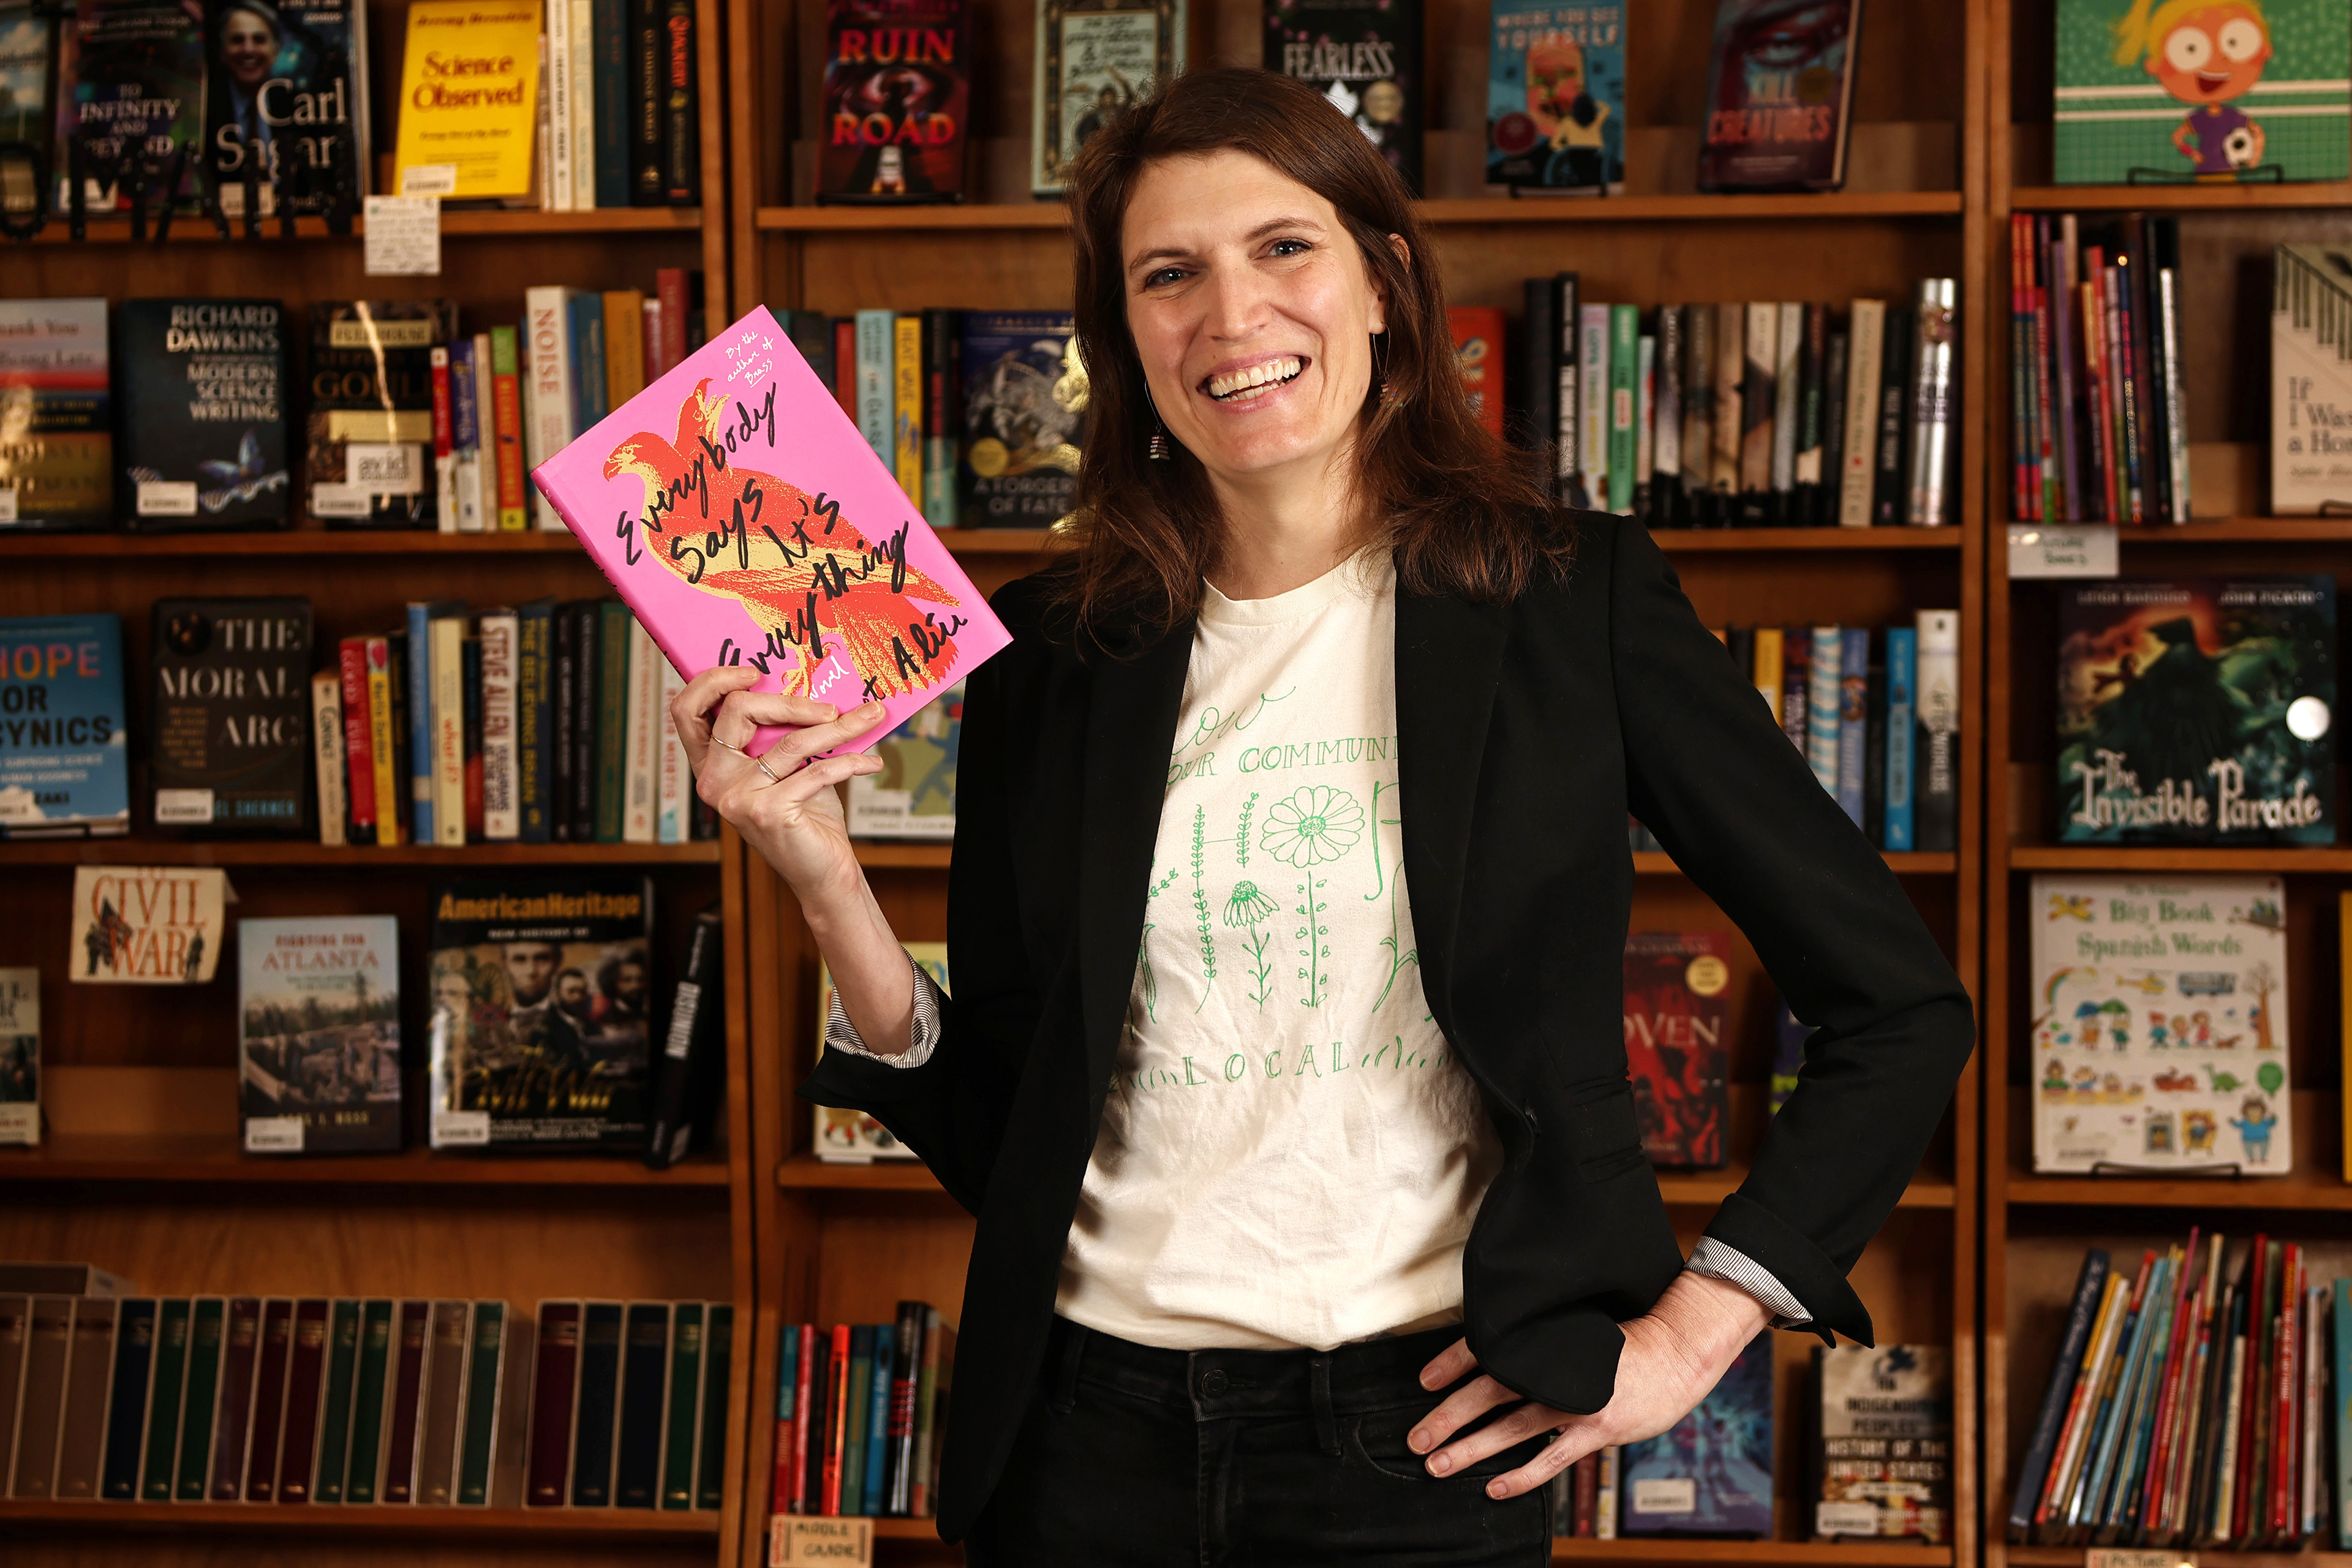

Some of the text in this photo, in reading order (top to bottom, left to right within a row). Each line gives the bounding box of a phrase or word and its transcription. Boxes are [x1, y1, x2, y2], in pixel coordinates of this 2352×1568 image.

[838, 28, 954, 64] RUIN
[1284, 40, 1395, 80] FEARLESS
[421, 50, 514, 80] Science
[80, 98, 181, 124] INFINITY
[256, 77, 347, 126] Carl
[412, 78, 525, 111] Observed
[832, 113, 956, 146] ROAD
[172, 305, 279, 328] RICHARD
[166, 328, 280, 353] DAWKINS
[533, 307, 560, 395] NOISE
[741, 331, 758, 344] the
[187, 363, 277, 380] MODERN
[728, 336, 774, 382] author of
[744, 358, 772, 385] Brass
[196, 382, 277, 400] SCIENCE
[189, 401, 280, 423] WRITING
[616, 382, 777, 566] Everybody
[671, 478, 763, 584] Says
[216, 617, 302, 652] THE
[892, 612, 968, 680] Aliu
[0, 641, 101, 680] OPE
[160, 666, 301, 700] MORAL
[483, 626, 512, 736] STEVE ALLEN
[217, 714, 303, 748] ARC
[2095, 748, 2141, 795] The
[2070, 758, 2322, 832] Invisible Parade
[91, 875, 208, 930] CIVIL
[2110, 899, 2215, 925] Big Book
[109, 927, 187, 977] WAR
[262, 948, 379, 972] ATLANTA
[2077, 933, 2243, 962] Spanish Words
[1183, 1042, 1349, 1085] LOCAL
